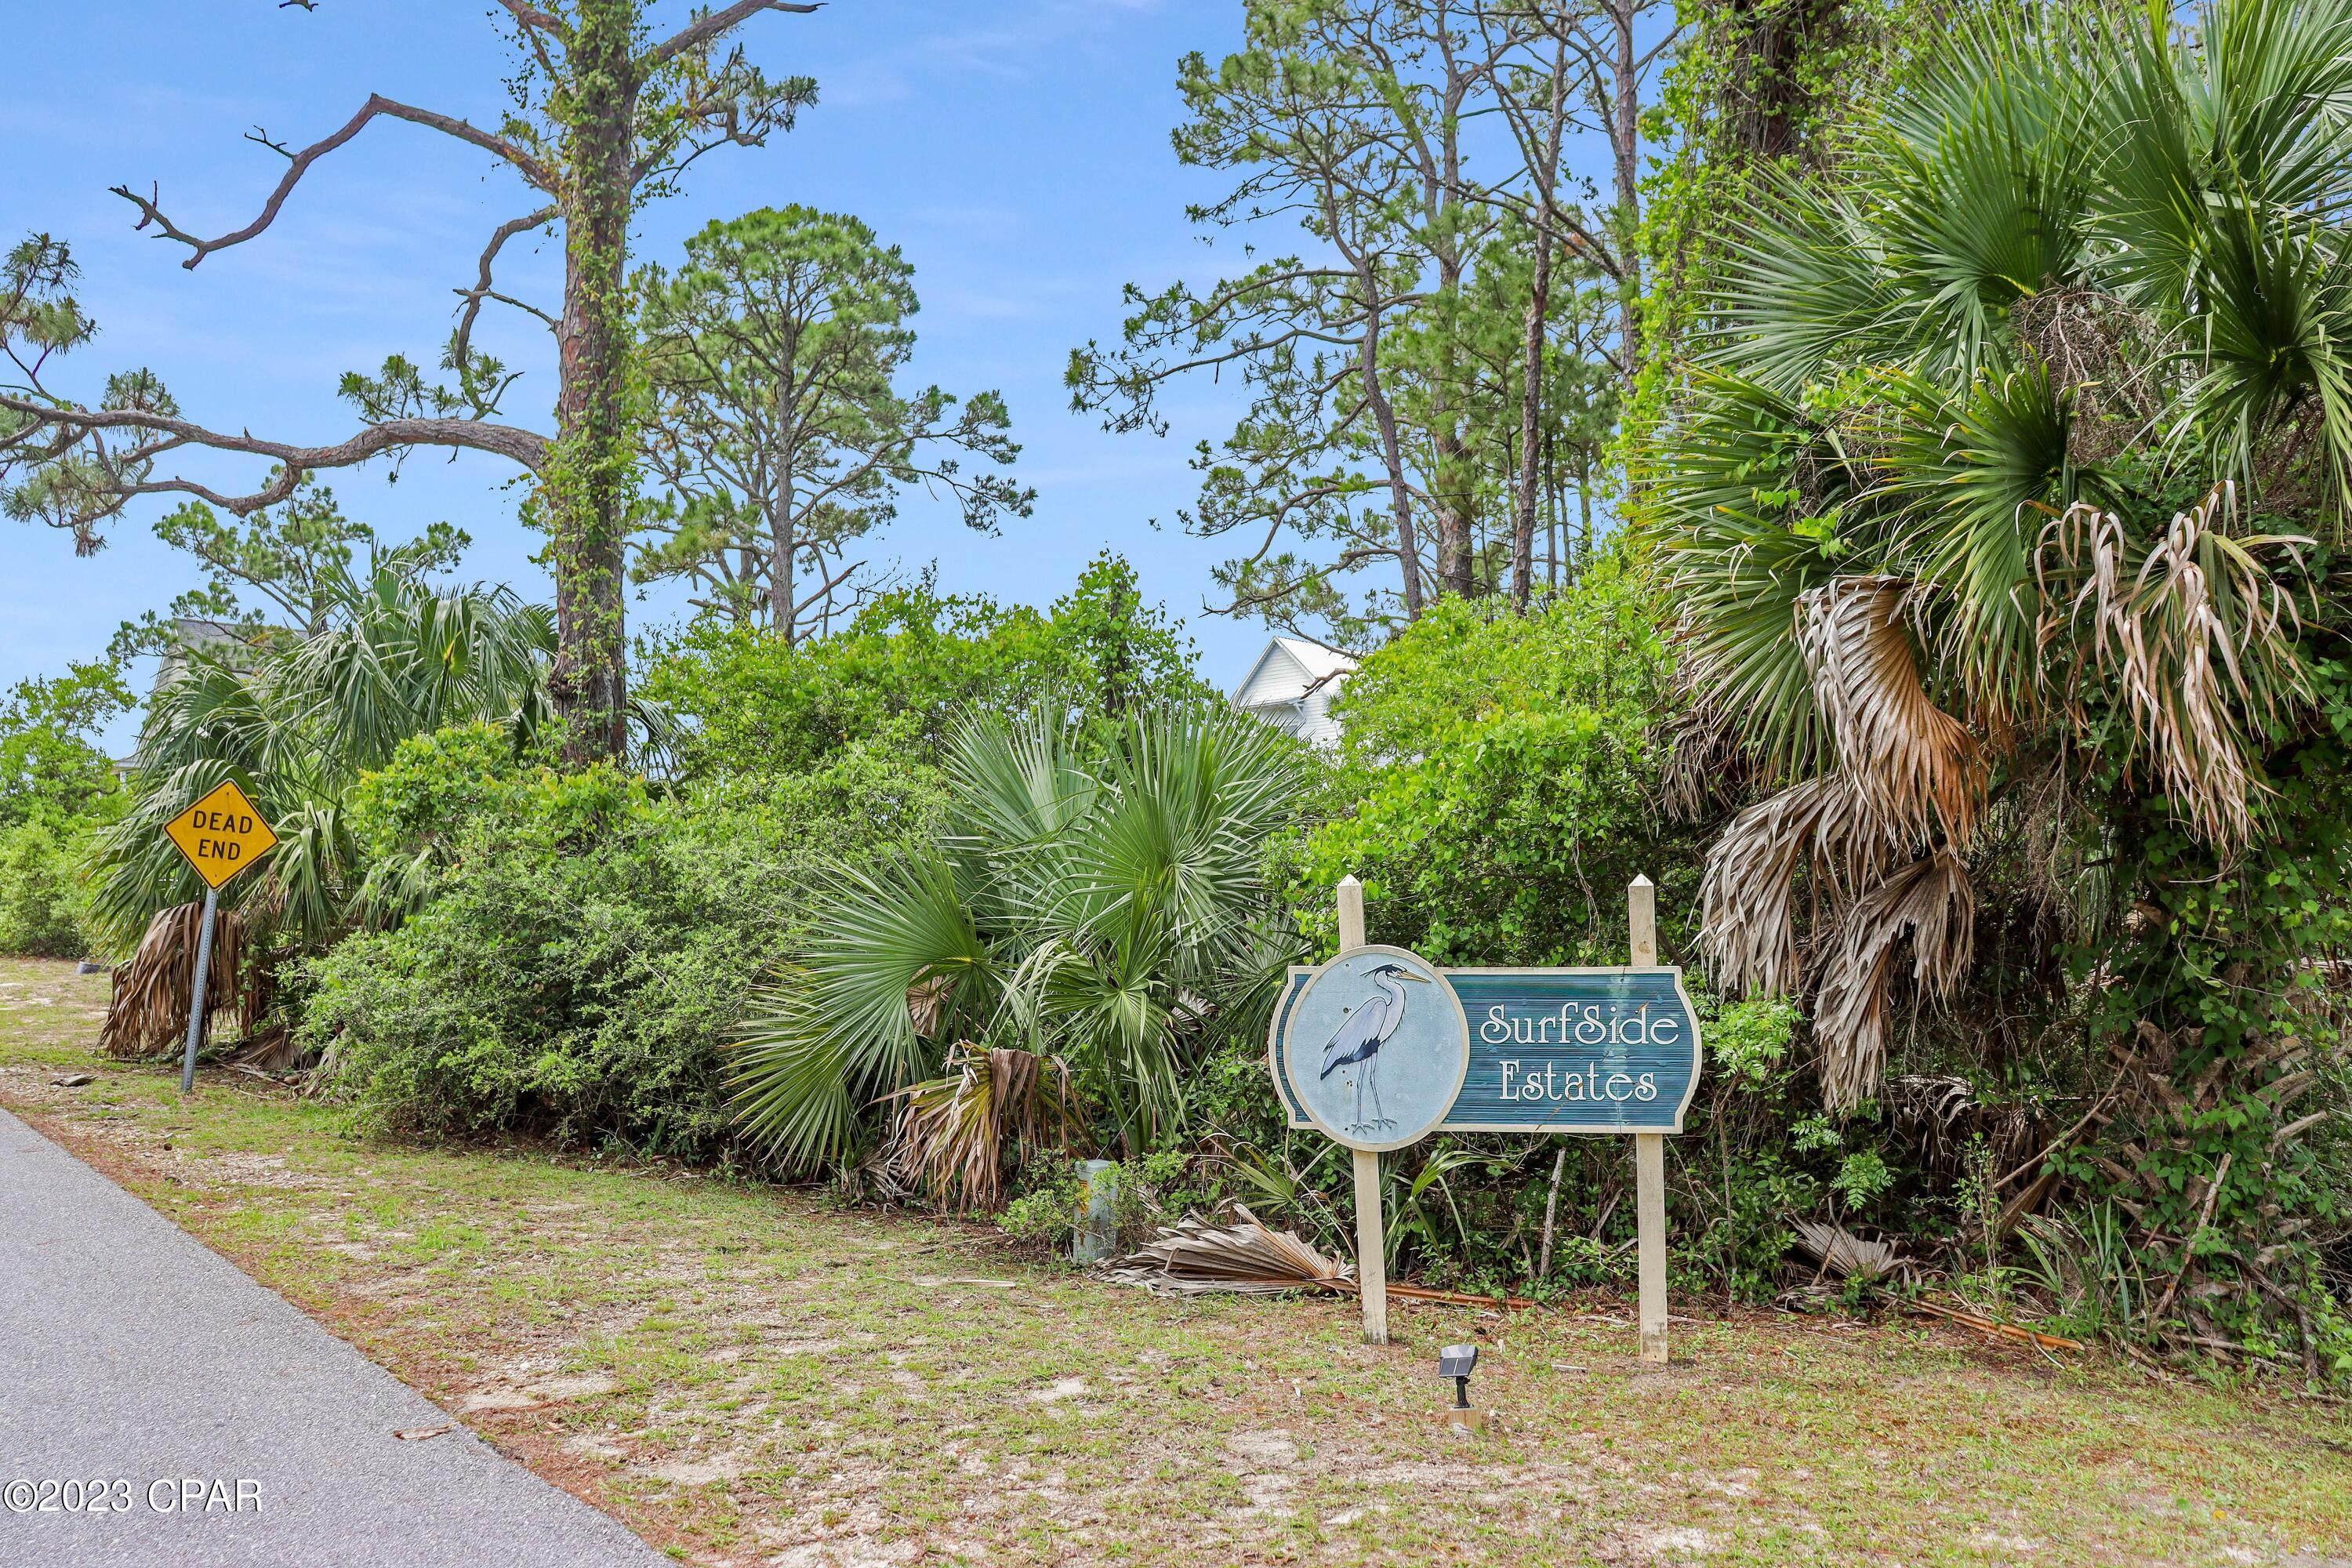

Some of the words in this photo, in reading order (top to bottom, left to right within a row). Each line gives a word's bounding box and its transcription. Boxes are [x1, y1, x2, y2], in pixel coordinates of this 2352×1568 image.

[193, 810, 253, 834] DEAD
[198, 839, 241, 860] END
[1499, 1059, 1657, 1102] Estates
